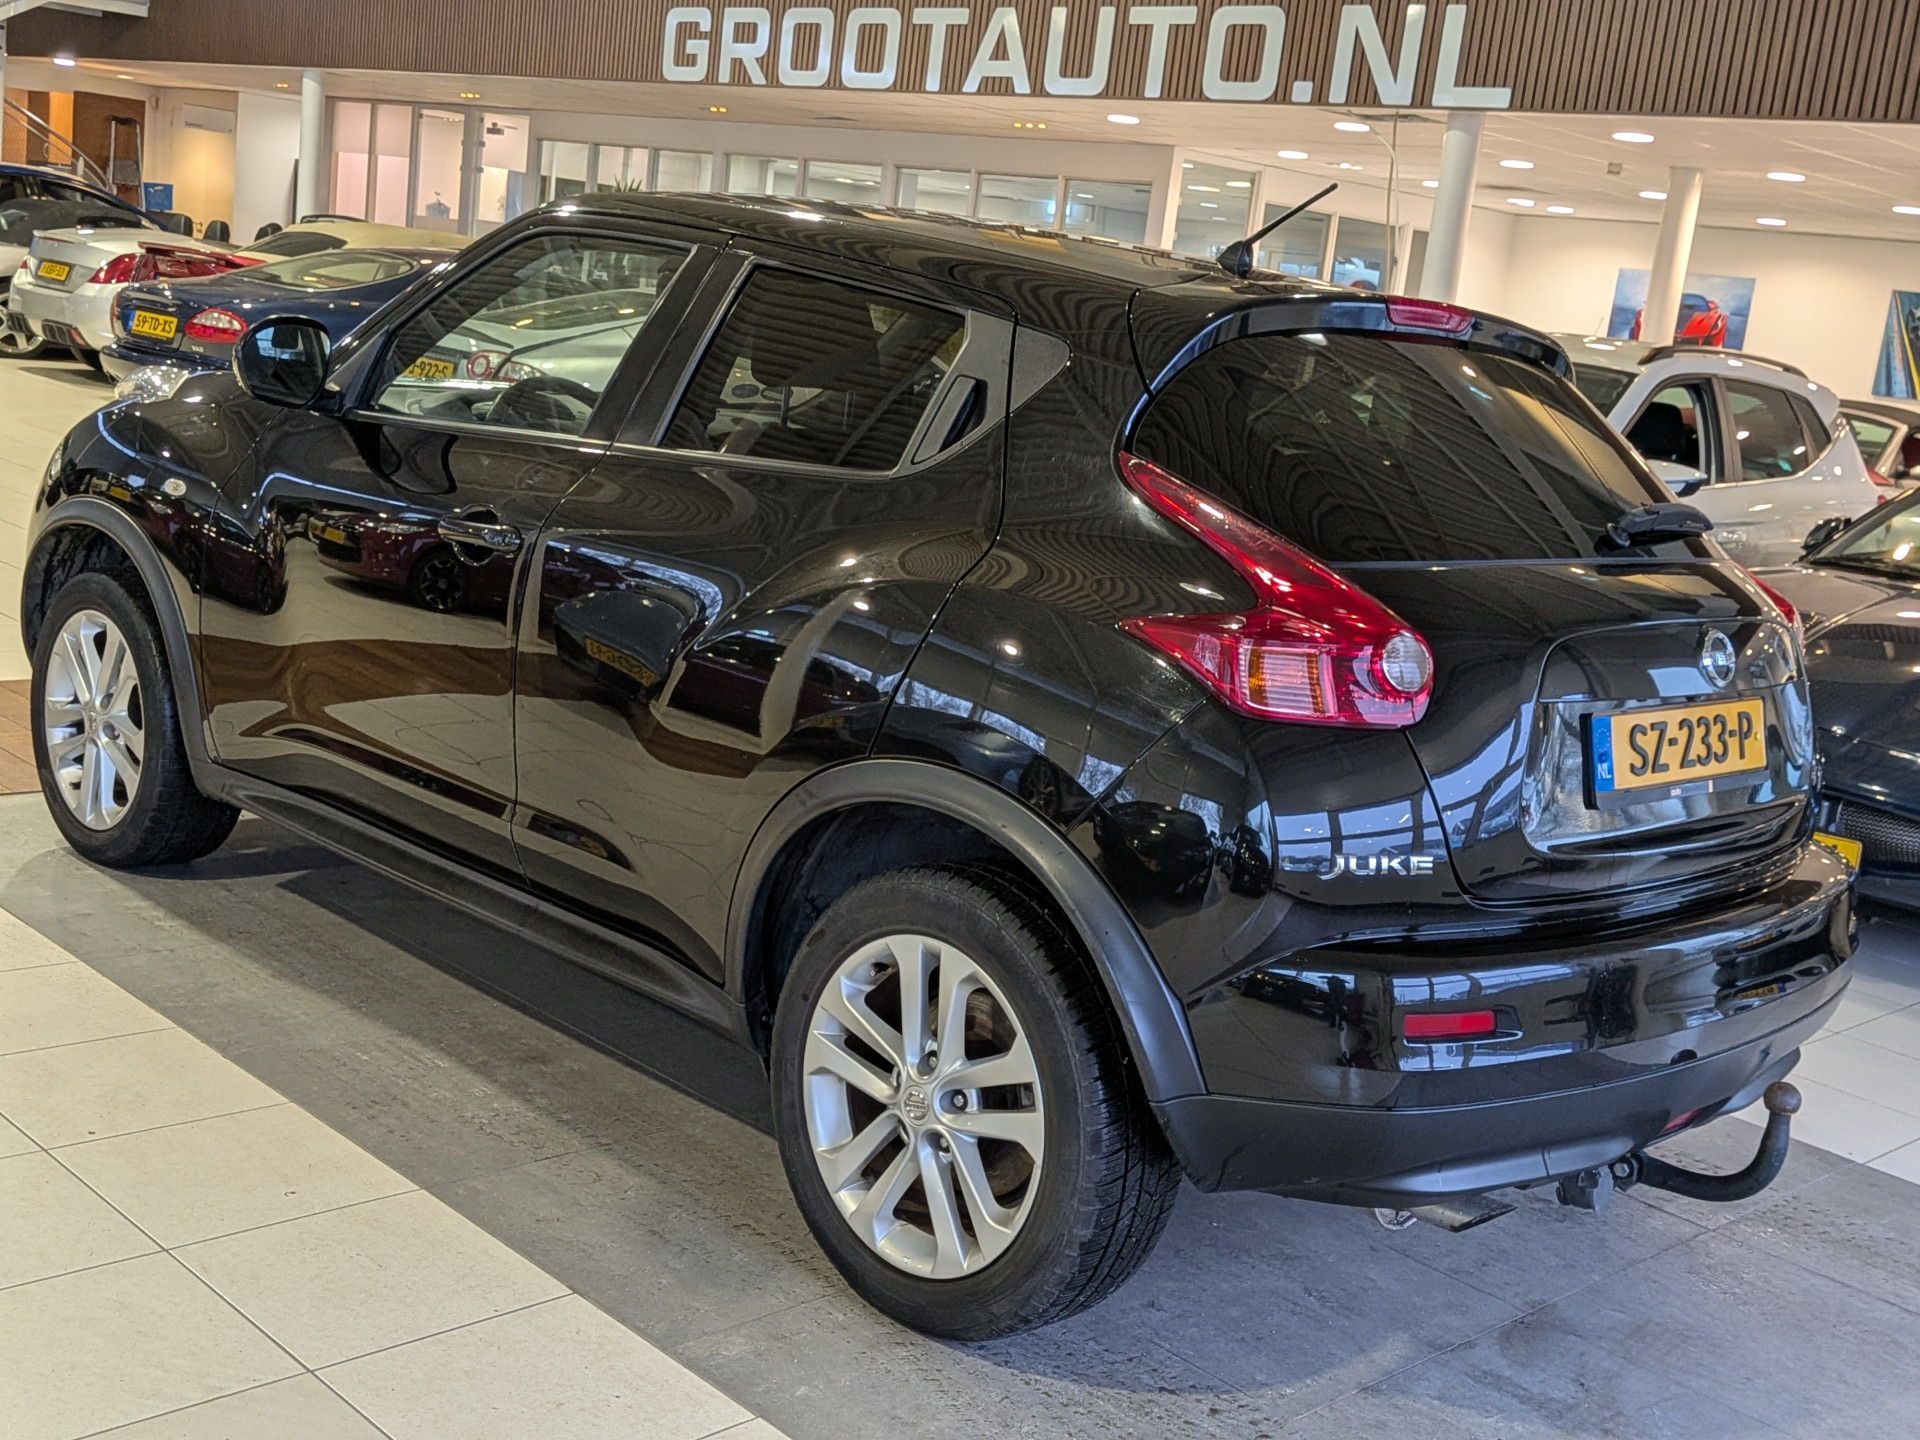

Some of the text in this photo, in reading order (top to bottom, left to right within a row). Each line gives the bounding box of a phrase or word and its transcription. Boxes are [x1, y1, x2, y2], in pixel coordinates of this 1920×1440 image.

[662, 4, 1512, 109] GROOTAUTO.NL
[135, 314, 174, 334] 59-TD-XS
[1629, 711, 1753, 776] SZ-233-P
[1597, 762, 1612, 780] NL
[1317, 854, 1434, 880] JUKE
